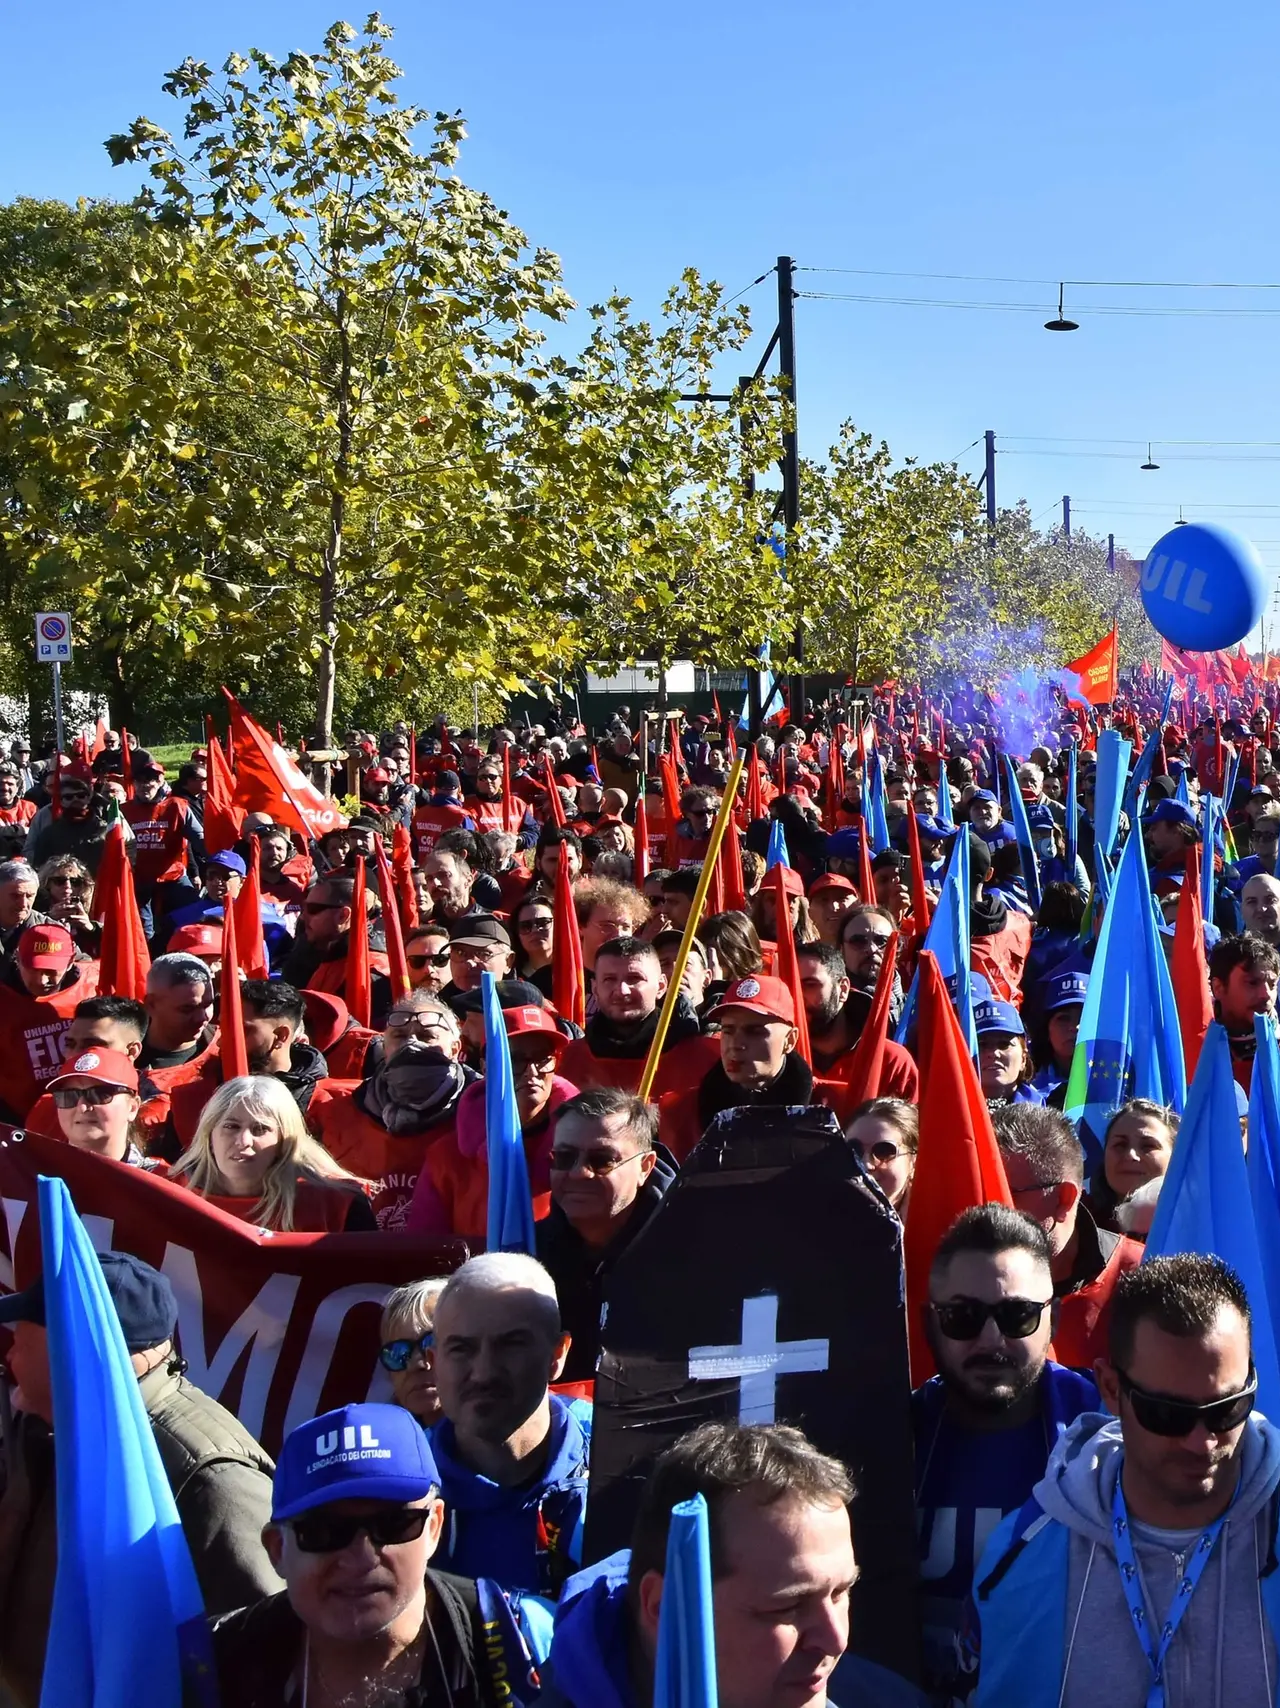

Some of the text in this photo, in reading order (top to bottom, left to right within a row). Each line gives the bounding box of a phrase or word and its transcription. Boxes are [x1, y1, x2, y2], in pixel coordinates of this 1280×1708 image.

[1141, 552, 1212, 615] UIL
[1061, 979, 1087, 990] UIL
[975, 1006, 1001, 1019] UIL
[23, 1021, 62, 1039] UNIAMO
[316, 1424, 379, 1456] UIL
[312, 1453, 347, 1472] SINDACATO
[348, 1450, 360, 1461] DEI
[360, 1448, 391, 1460] CITTADINI
